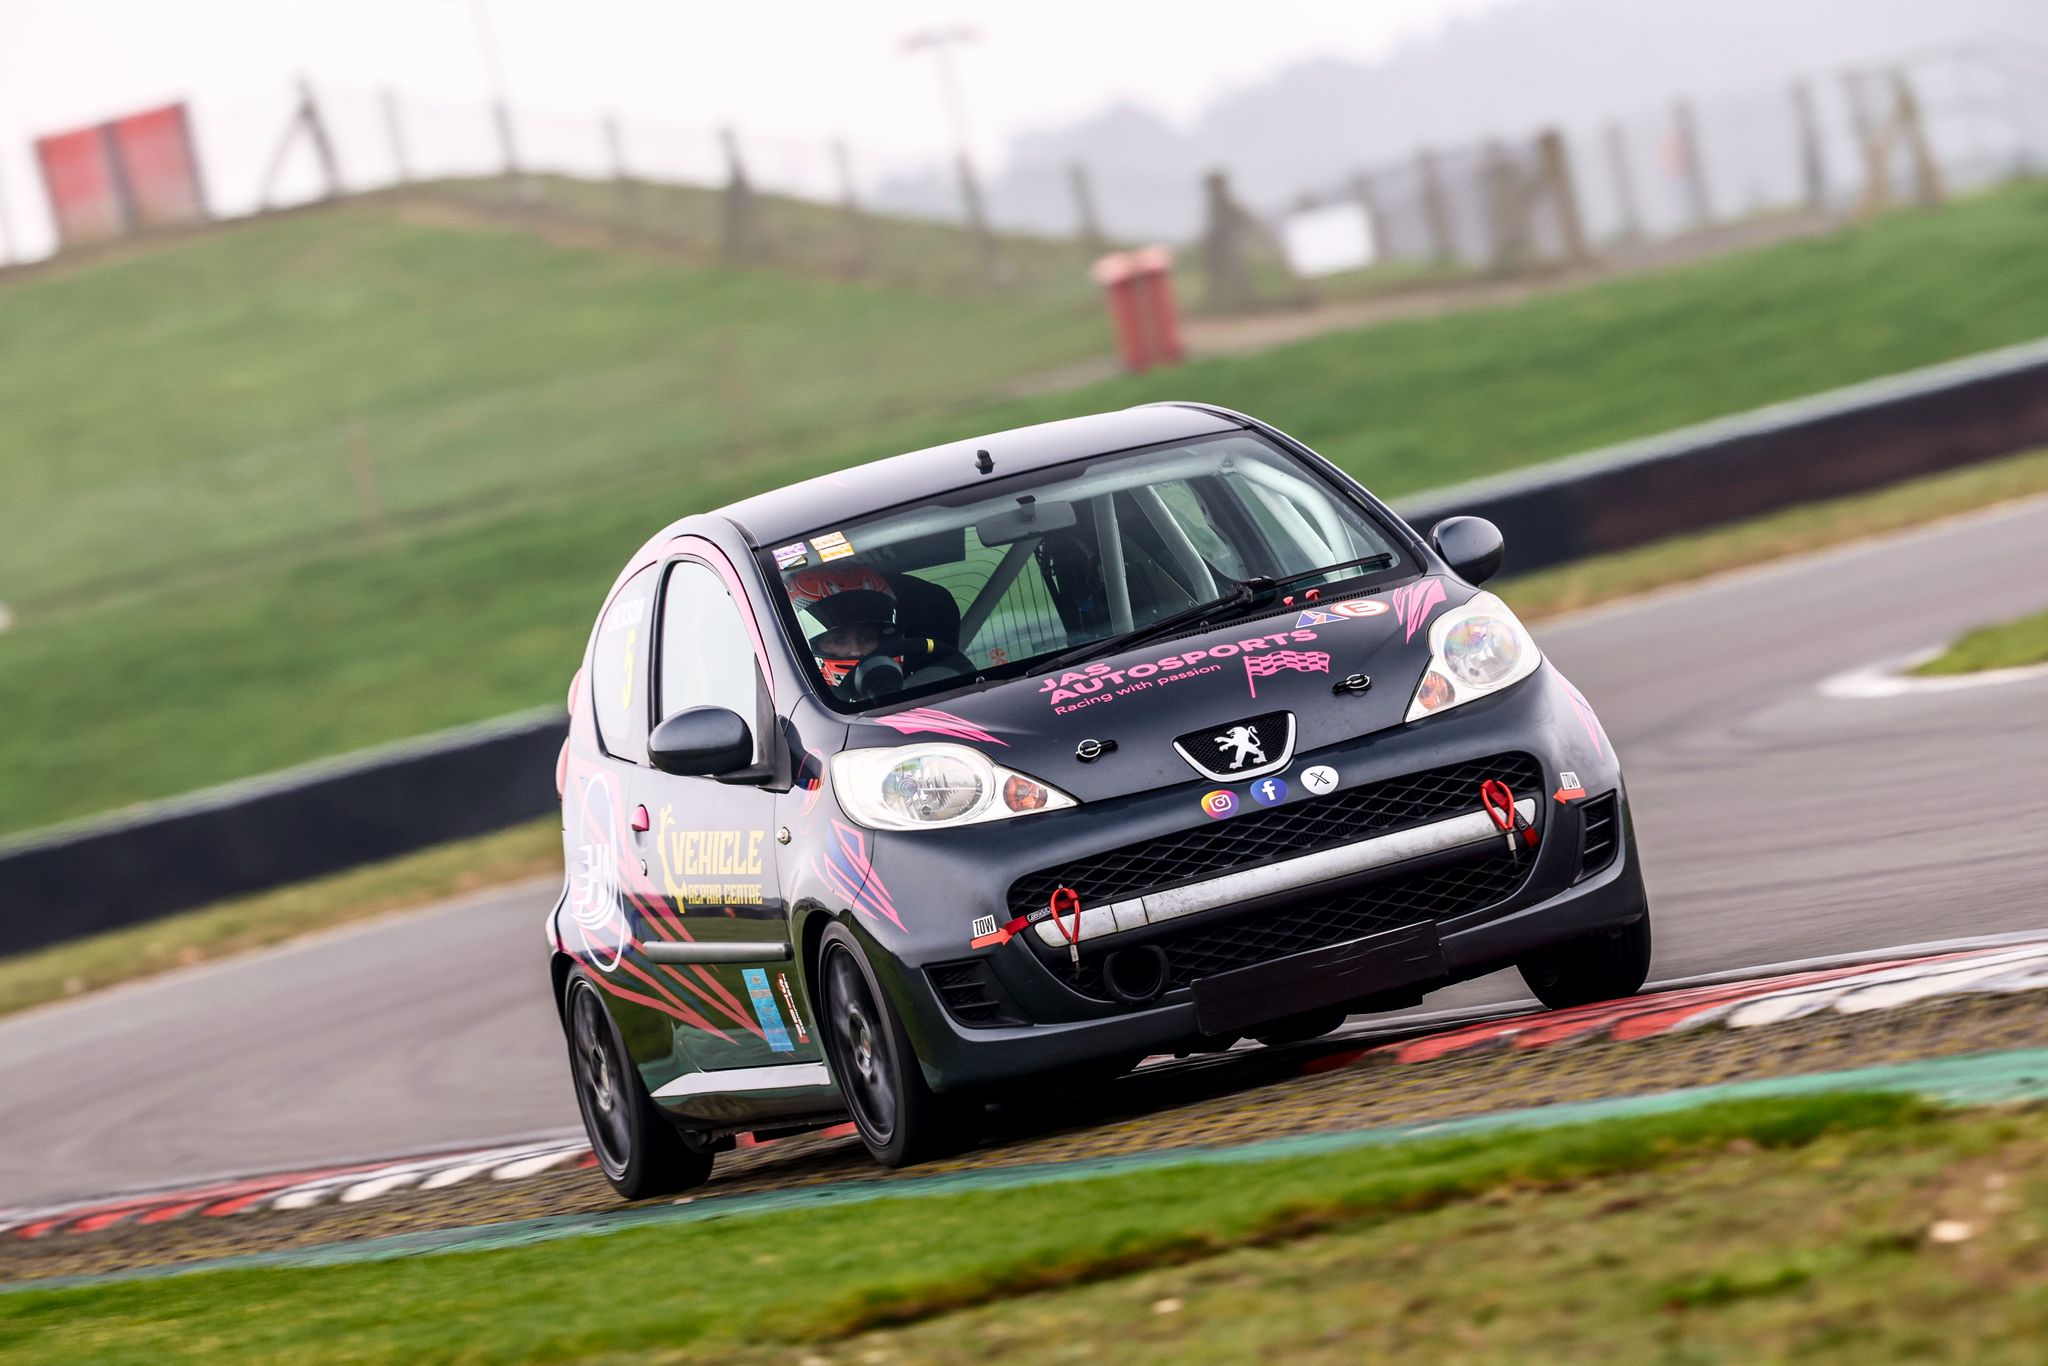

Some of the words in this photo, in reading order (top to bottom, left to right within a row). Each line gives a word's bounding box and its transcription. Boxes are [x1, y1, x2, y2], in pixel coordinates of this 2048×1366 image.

[1038, 663, 1112, 692] JAS
[1050, 629, 1318, 704] AUTOSPORTS
[1054, 692, 1114, 716] Racing
[1117, 677, 1153, 696] with
[1157, 664, 1221, 687] passion
[671, 830, 765, 875] VEHICLE
[687, 883, 722, 905] REPAIR
[724, 883, 763, 905] CENTRE
[974, 915, 994, 936] TOW
